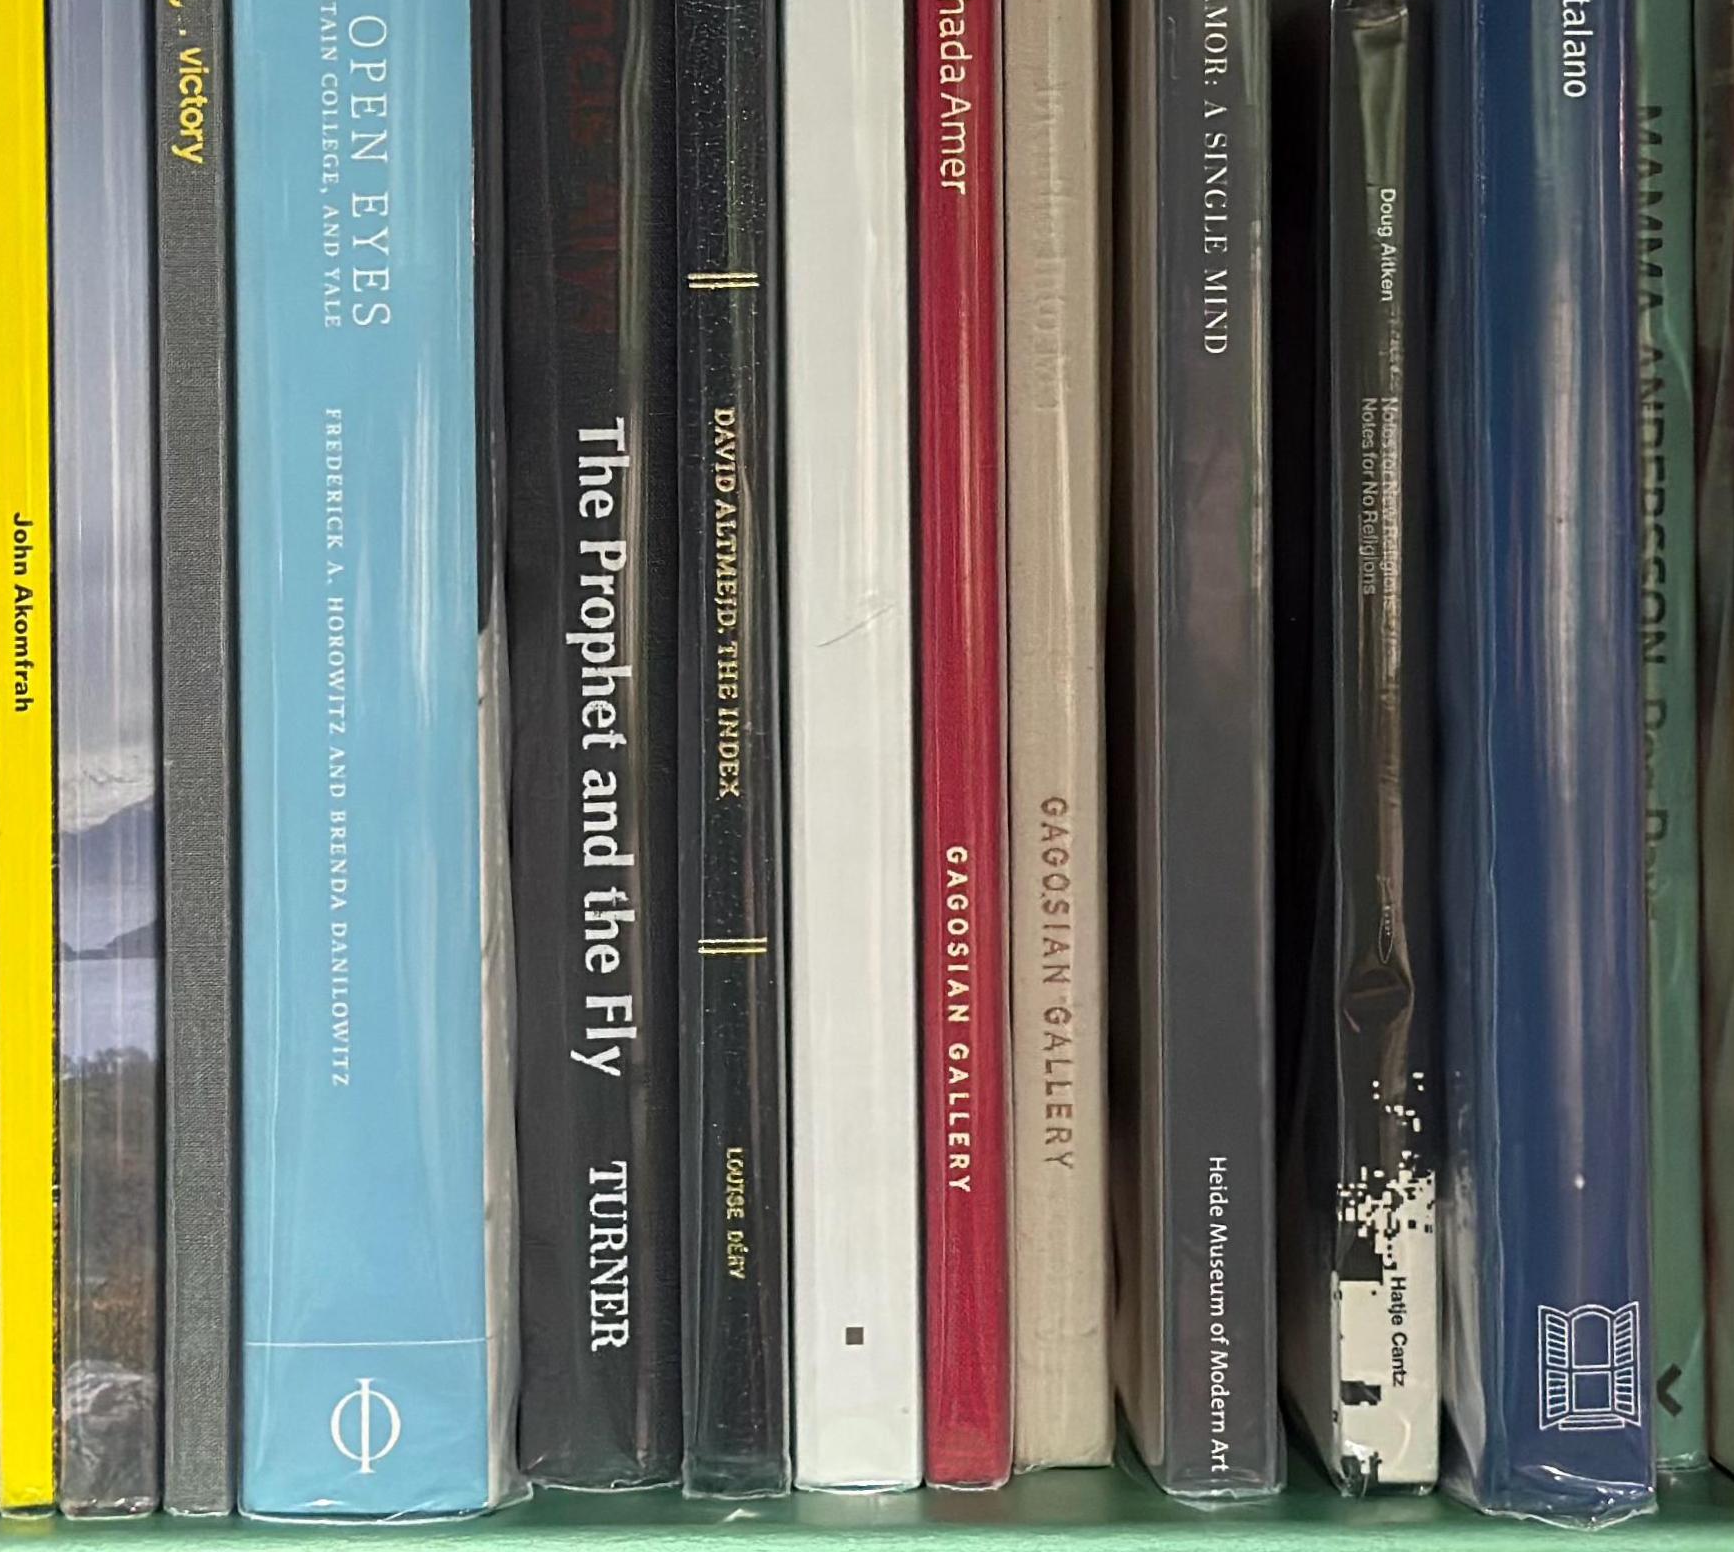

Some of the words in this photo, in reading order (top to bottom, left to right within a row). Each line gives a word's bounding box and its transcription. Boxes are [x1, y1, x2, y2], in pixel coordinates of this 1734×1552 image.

[348, 15, 389, 163] OPEN
[1204, 100, 1228, 118] A
[319, 73, 340, 194] COLLEGE,
[939, 92, 972, 196] Amer
[322, 205, 340, 257] AND
[1204, 132, 1228, 254] SINGLE
[1376, 188, 1397, 237] Doug
[324, 267, 342, 328] YALE
[351, 191, 392, 326] EYES
[1380, 243, 1397, 302] Aitken
[1204, 269, 1228, 354] MIND
[577, 415, 629, 520] The
[714, 408, 736, 493] DAVID
[13, 511, 34, 577] John
[13, 583, 35, 713] Akomfrah
[565, 536, 632, 750] Prophet
[717, 640, 739, 700] THE
[718, 707, 740, 798] INDEX
[582, 769, 635, 867] and
[583, 886, 636, 974] the
[946, 846, 970, 1022] GAGOSIAN
[570, 994, 638, 1077] Fly
[948, 1043, 971, 1192] GALLERY
[1209, 1157, 1229, 1217] Heide
[589, 1160, 630, 1352] TURNER
[1209, 1223, 1228, 1317] Museum
[1210, 1322, 1230, 1346] of
[1210, 1350, 1231, 1433] Modern
[1211, 1438, 1230, 1473] Art
